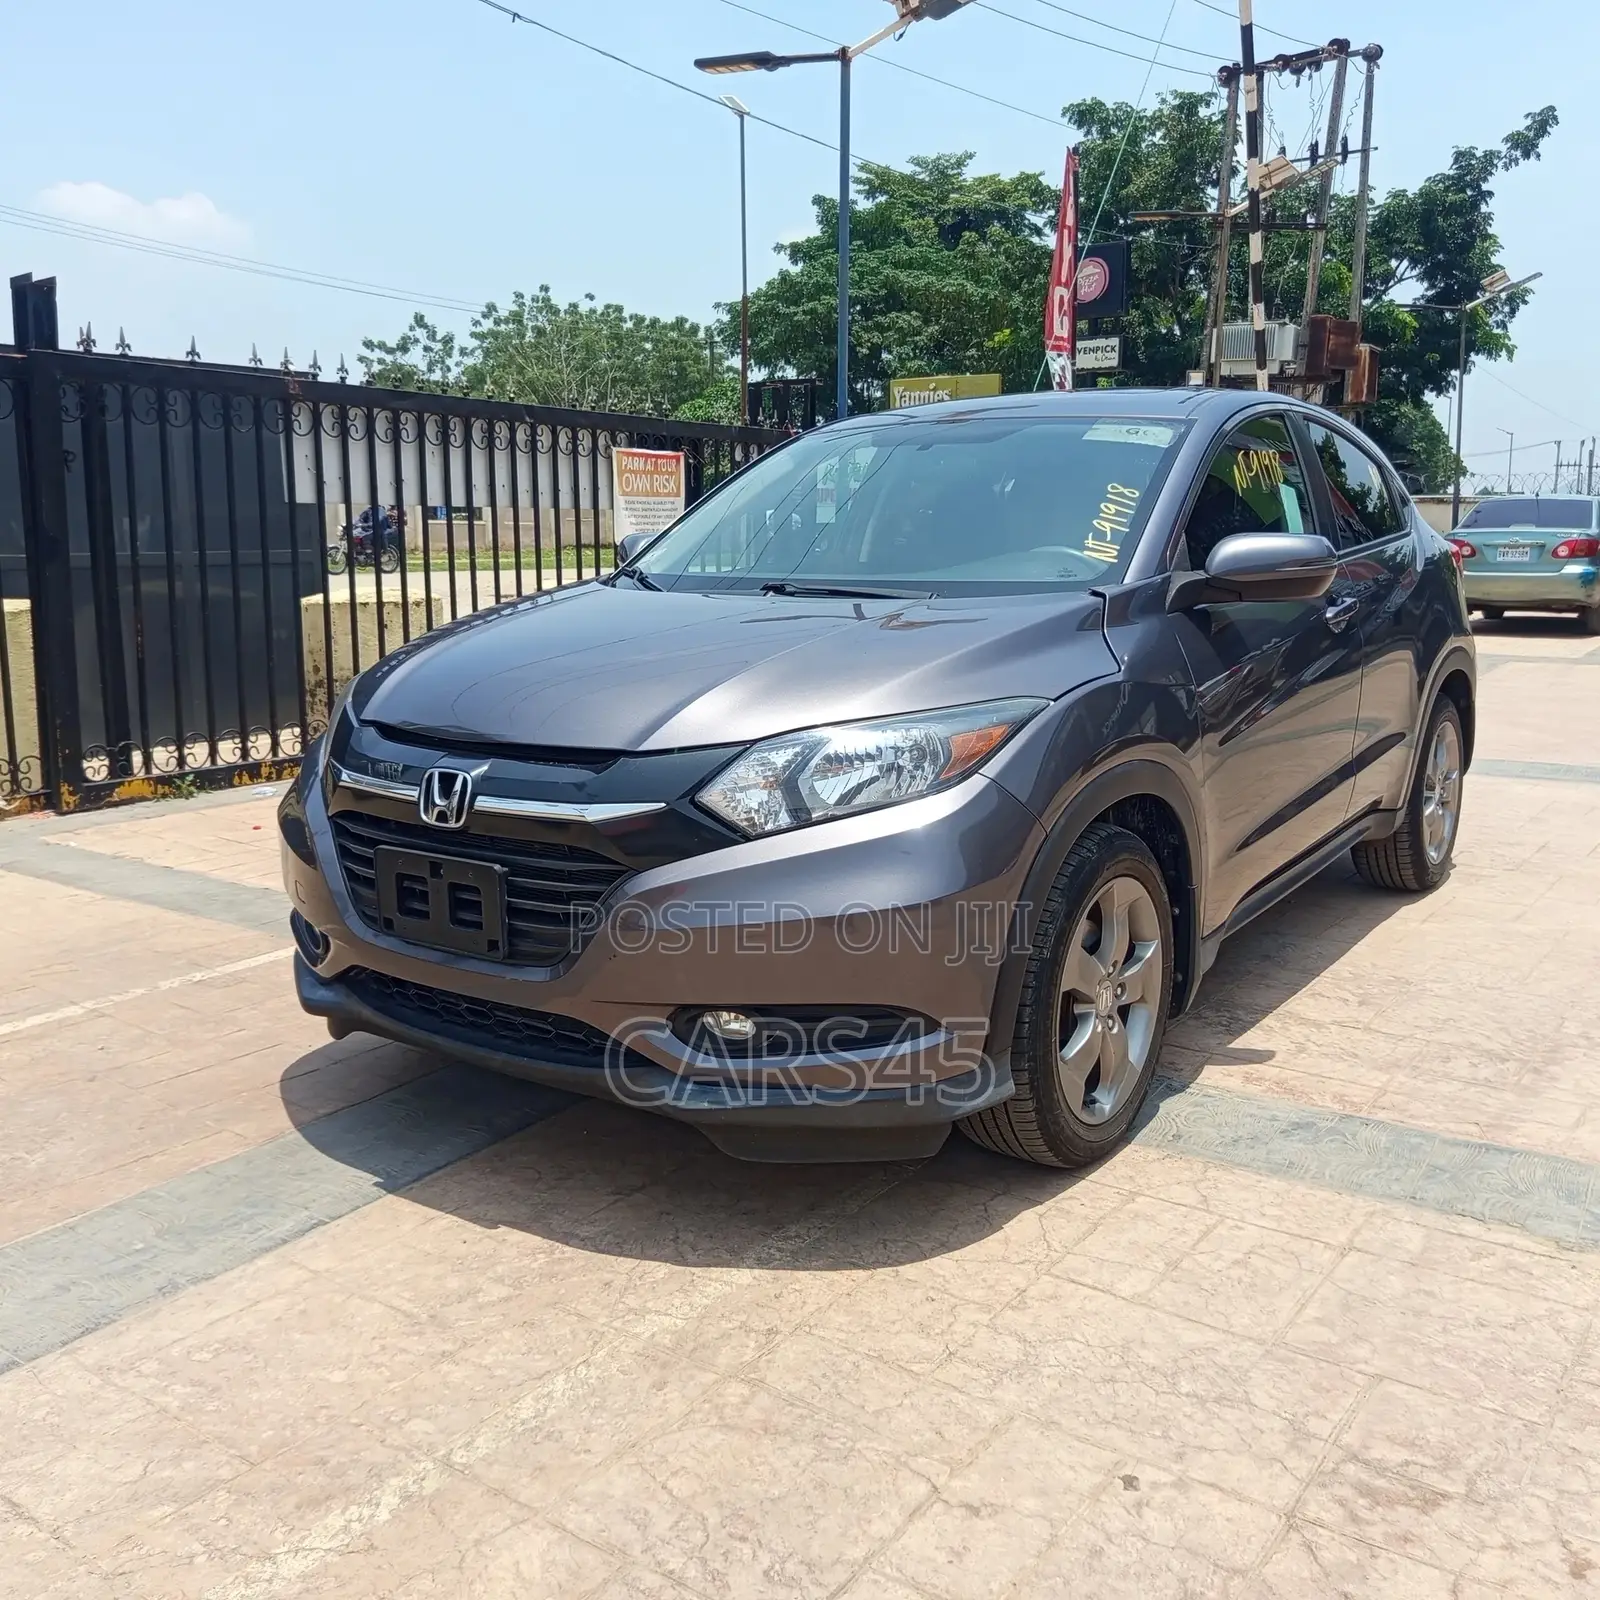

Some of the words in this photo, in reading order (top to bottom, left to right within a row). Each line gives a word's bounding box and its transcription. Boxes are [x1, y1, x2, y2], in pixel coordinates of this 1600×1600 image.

[1078, 274, 1099, 286] Pizza
[1080, 283, 1096, 296] Hut
[1077, 344, 1117, 356] VENPICK
[893, 383, 953, 408] Yannies
[622, 456, 645, 471] PARK
[645, 457, 655, 472] AT
[657, 458, 677, 472] YOUR
[622, 473, 650, 493] OWN
[653, 474, 677, 493] RISK
[1083, 482, 1140, 563] NT-91918
